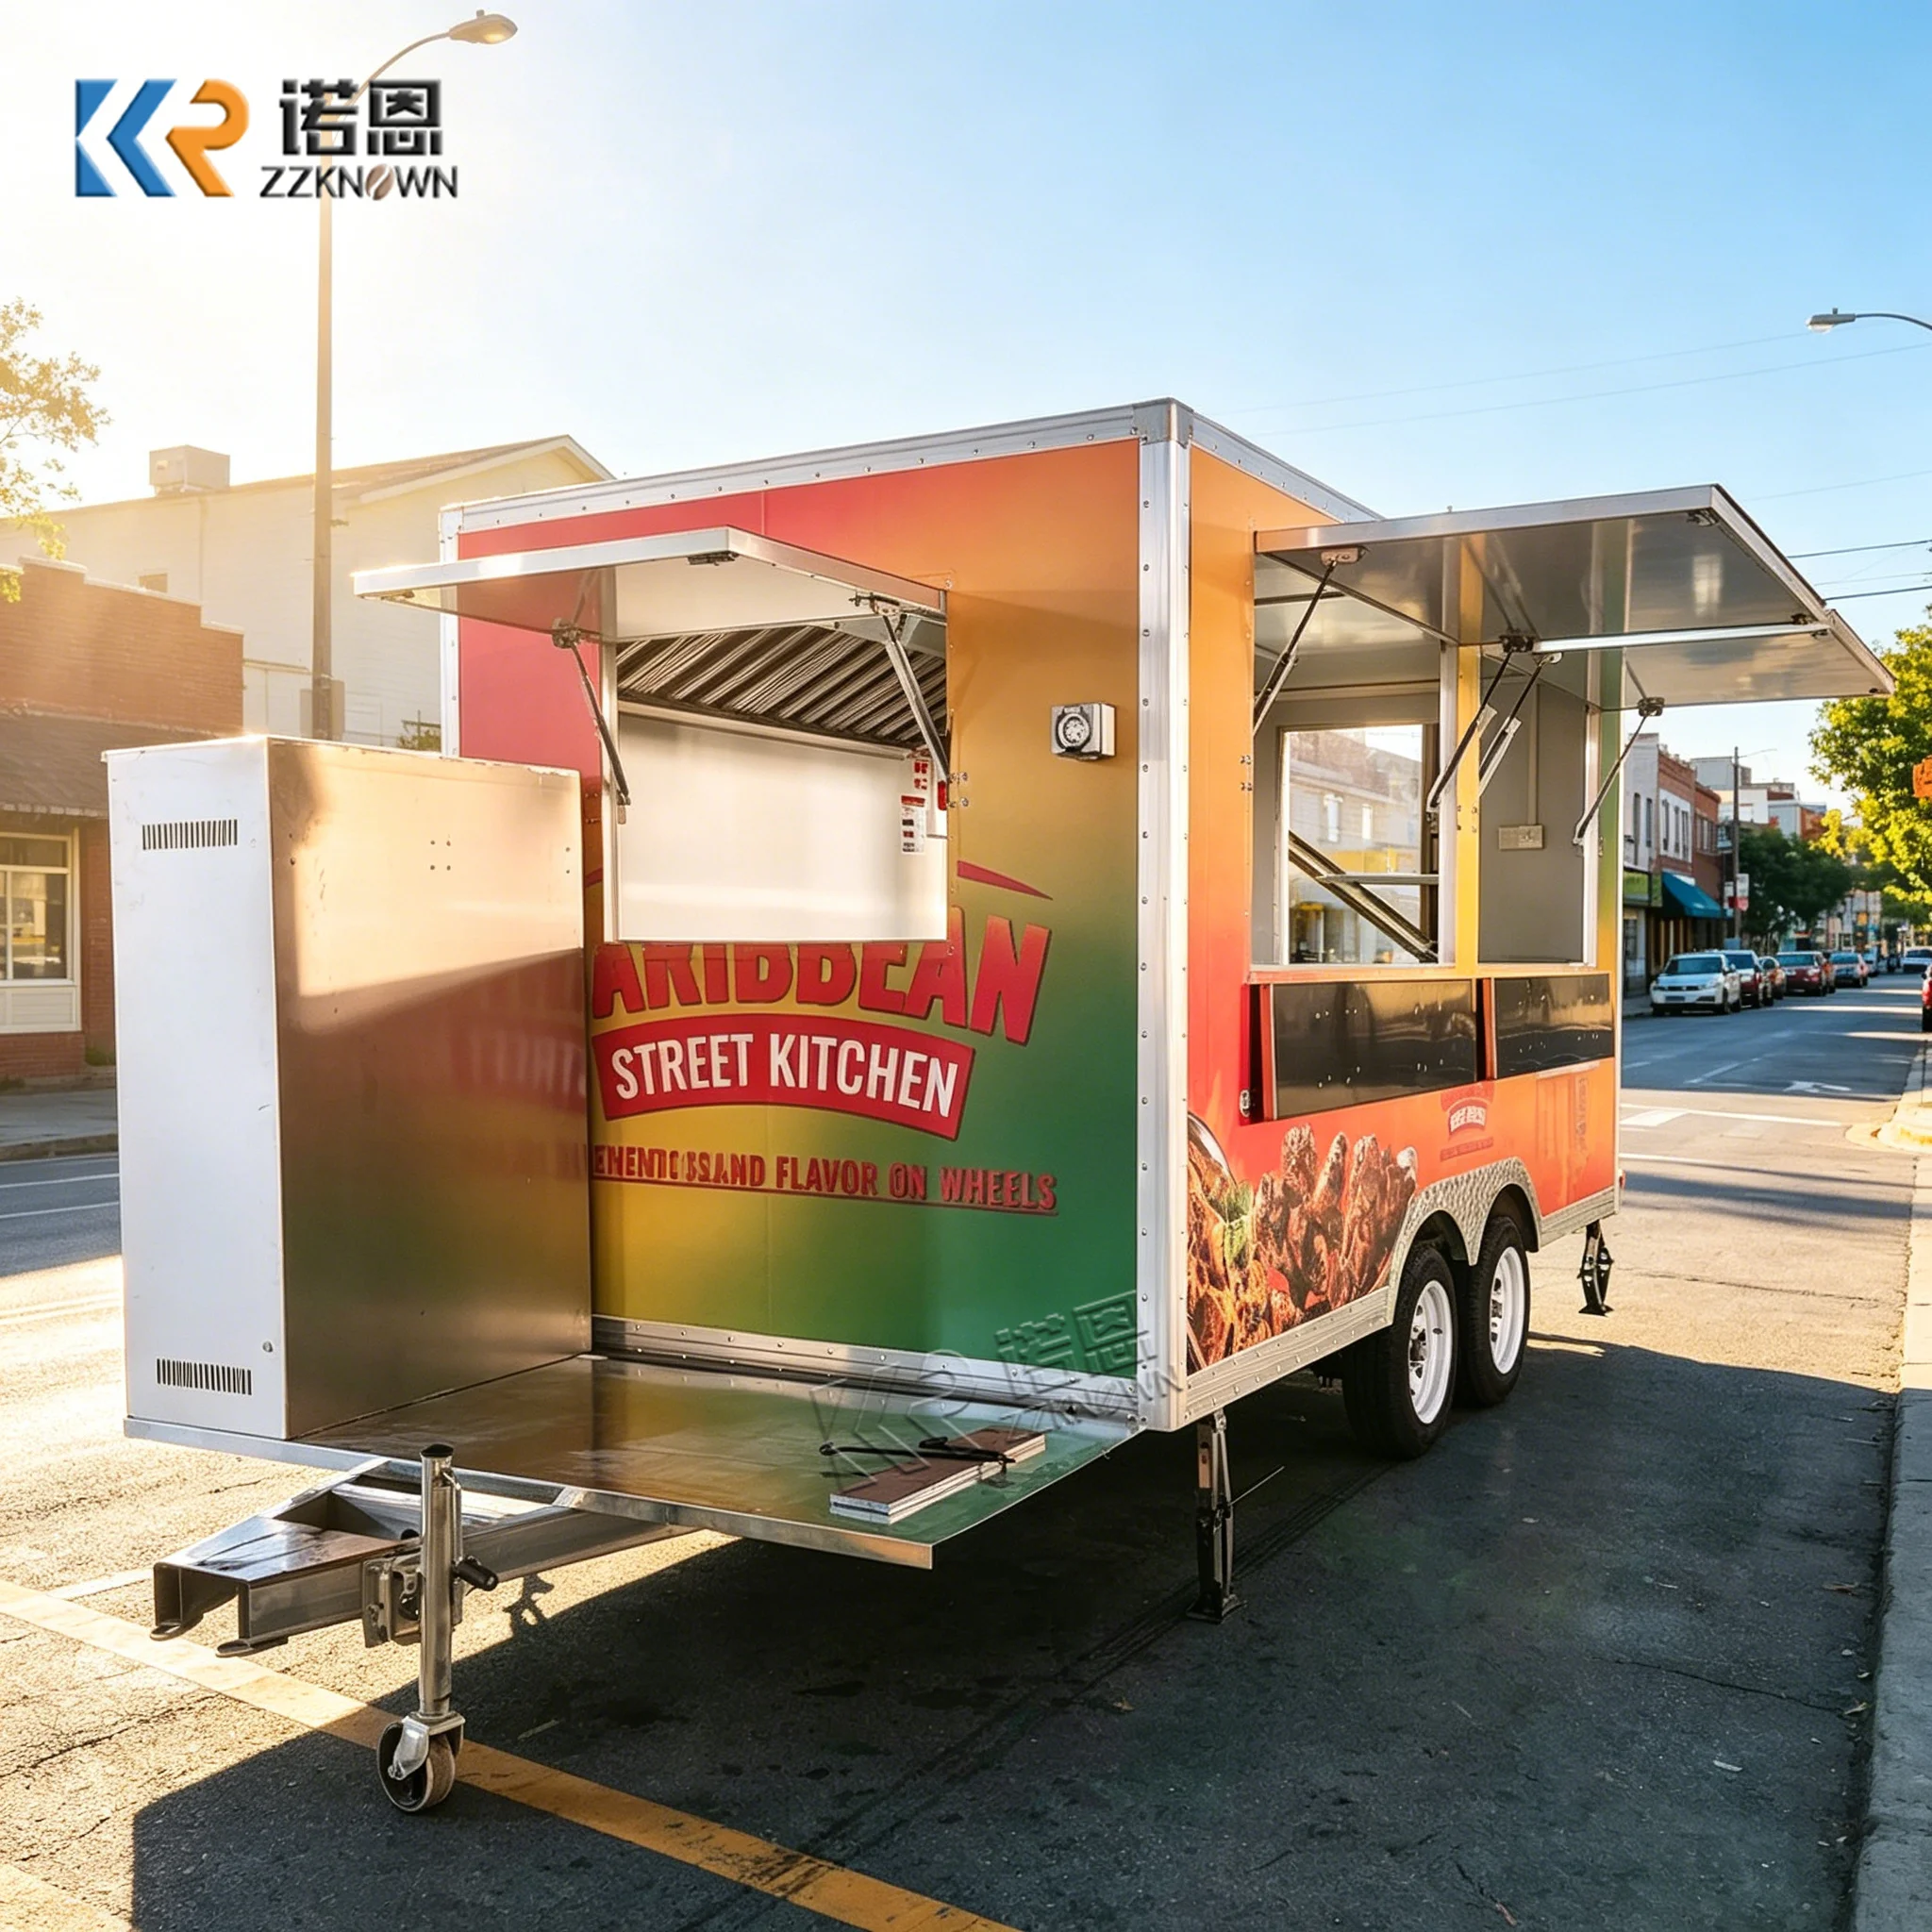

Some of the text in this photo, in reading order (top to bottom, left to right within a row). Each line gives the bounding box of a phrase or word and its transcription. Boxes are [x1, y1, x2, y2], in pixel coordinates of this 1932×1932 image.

[592, 904, 1052, 1046] ARIBBEAN
[611, 1033, 958, 1119] STREET KITCHEN
[775, 1156, 878, 1196] FLAVOR
[889, 1161, 927, 1201] ON
[940, 1166, 1057, 1211] WHEELS
